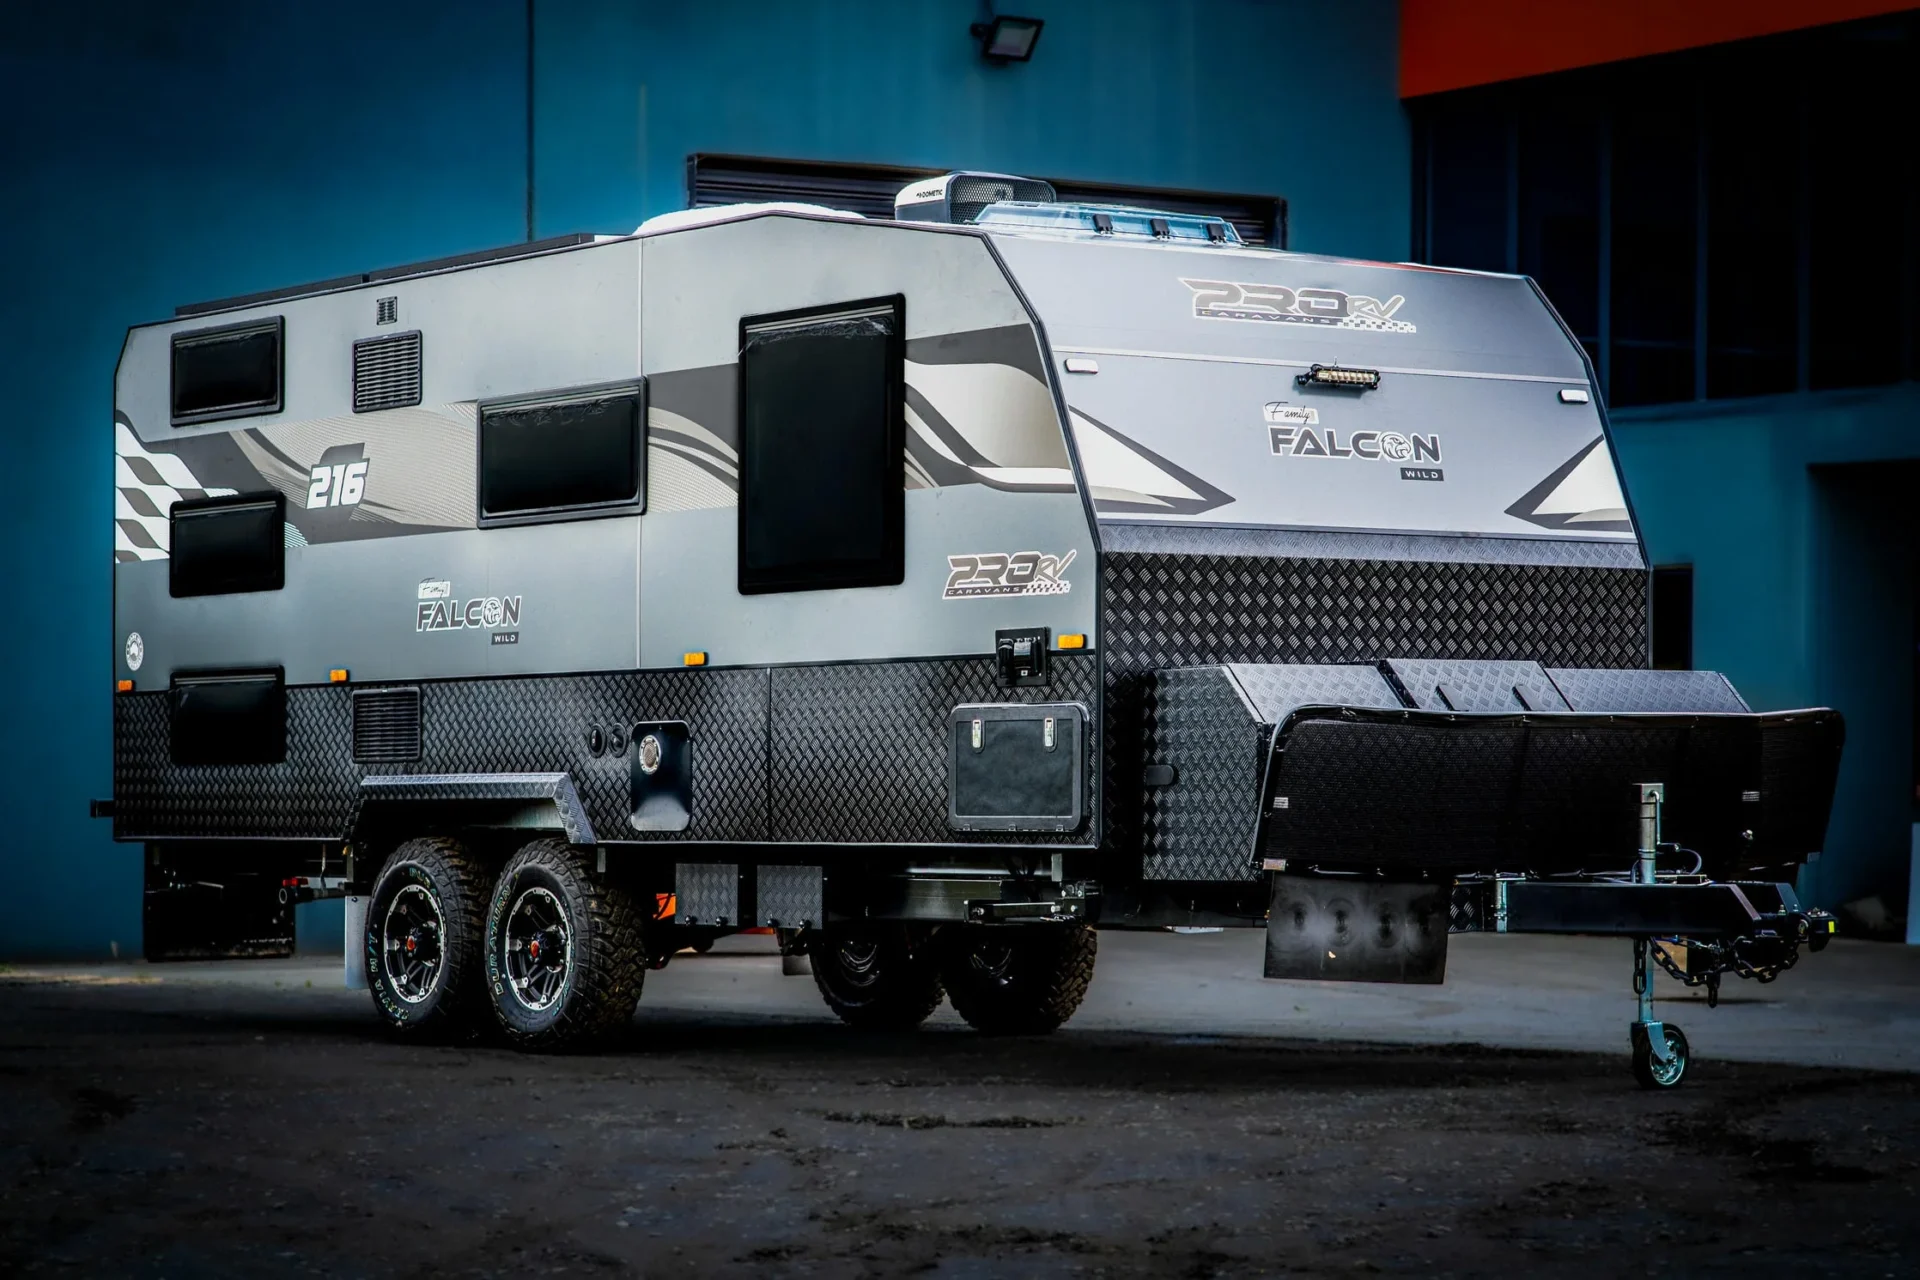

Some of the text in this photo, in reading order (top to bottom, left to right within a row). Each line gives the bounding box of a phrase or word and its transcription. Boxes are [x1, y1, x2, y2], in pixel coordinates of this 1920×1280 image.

[922, 188, 943, 198] DOMETIC
[1178, 278, 1349, 318] PRO
[1201, 309, 1331, 325] CARAVANS
[1265, 401, 1311, 425] Family
[1268, 424, 1442, 465] FALCON
[306, 461, 368, 509] 216
[1404, 469, 1439, 479] WILD
[946, 551, 1042, 588] PRO
[948, 586, 1020, 596] CARAVANS
[416, 596, 522, 632] FALCON
[494, 633, 516, 643] WILD
[489, 885, 511, 995] DURATURN
